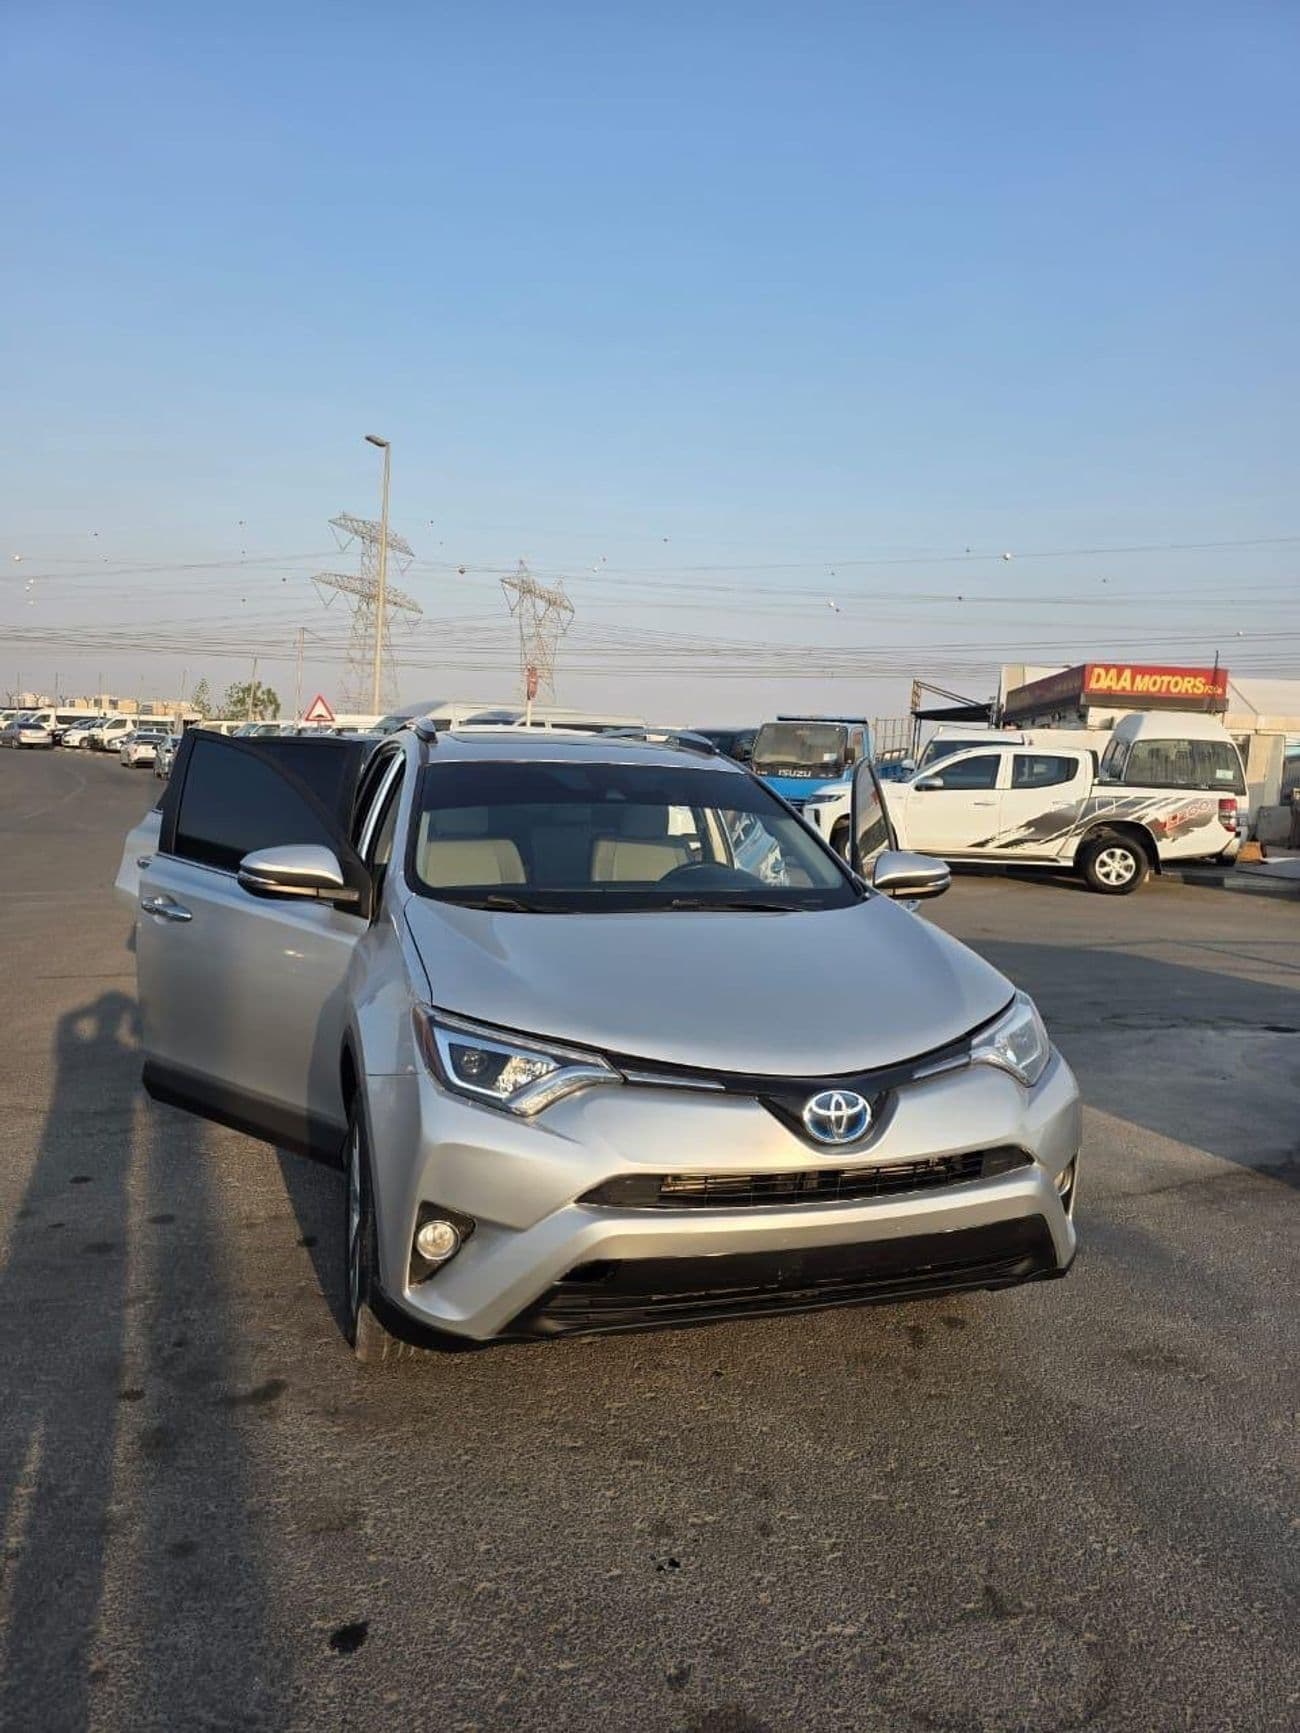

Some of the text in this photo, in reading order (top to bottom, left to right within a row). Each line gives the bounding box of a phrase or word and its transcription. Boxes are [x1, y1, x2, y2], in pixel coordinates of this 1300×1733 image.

[1089, 667, 1132, 691] DAA
[1133, 674, 1206, 694] MOTORS
[778, 768, 812, 777] ISUZU
